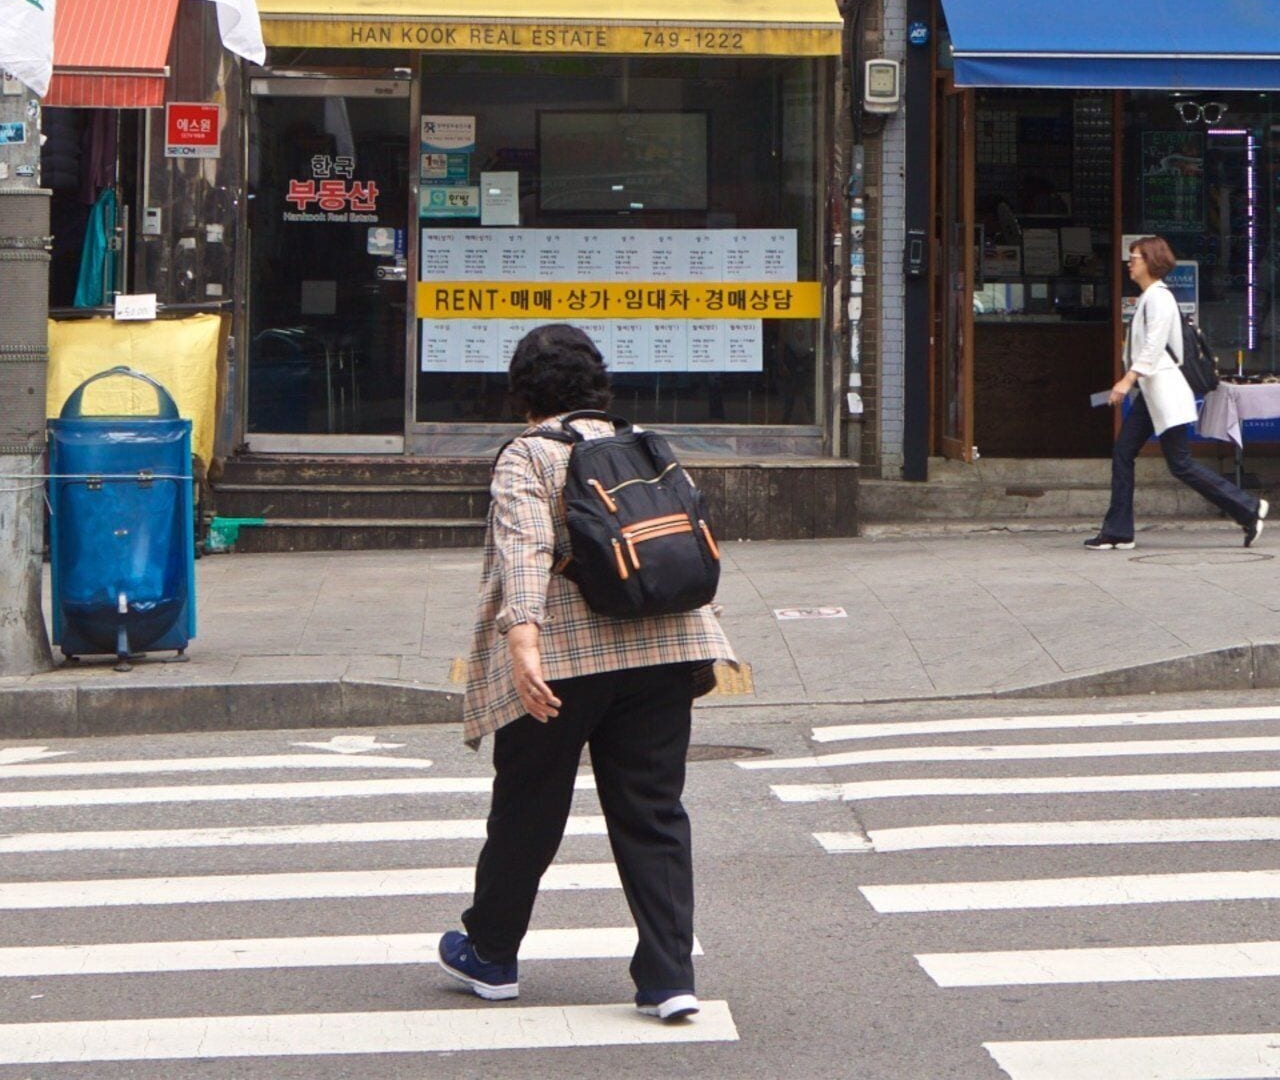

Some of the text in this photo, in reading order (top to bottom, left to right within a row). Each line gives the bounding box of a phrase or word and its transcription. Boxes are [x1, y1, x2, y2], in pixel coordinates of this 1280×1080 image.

[351, 27, 743, 49] HAN KOOK REAL ESTATE 749-1222
[176, 119, 211, 133] 에스원
[311, 154, 355, 179] 한국
[286, 179, 379, 211] 부동산
